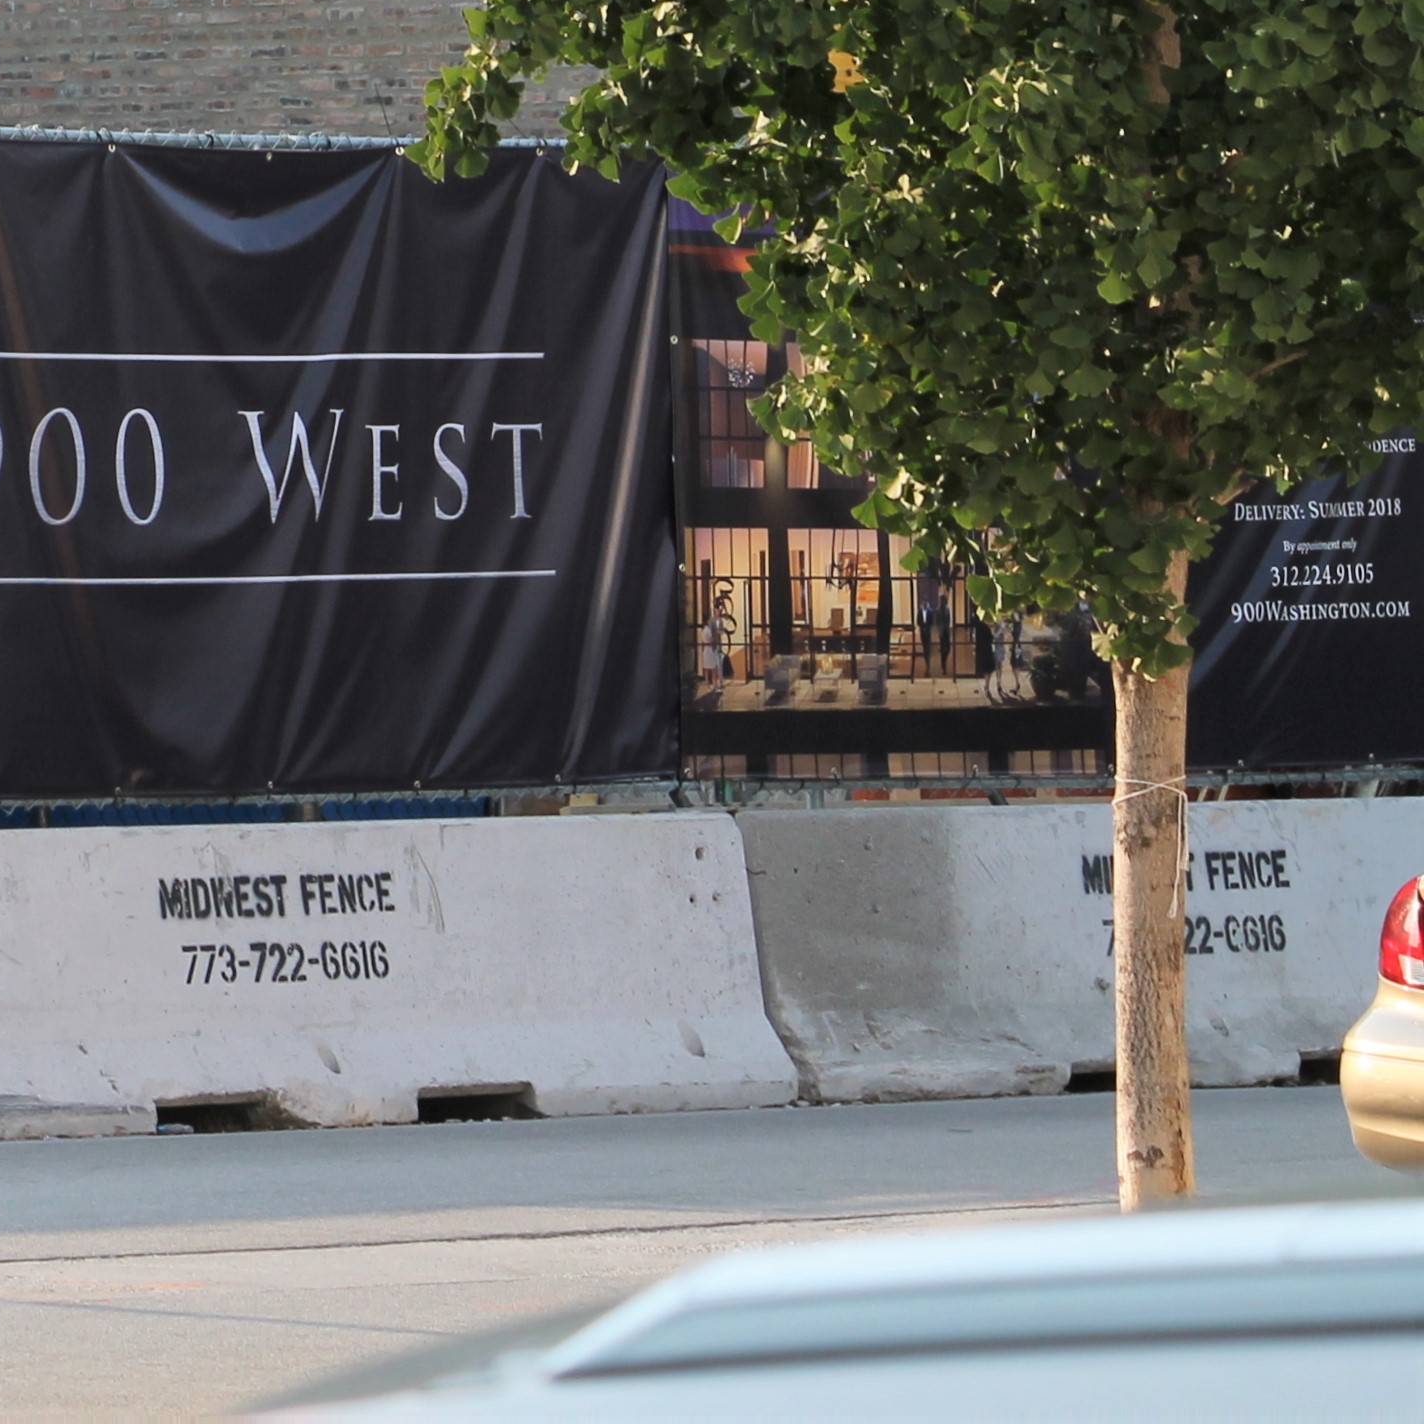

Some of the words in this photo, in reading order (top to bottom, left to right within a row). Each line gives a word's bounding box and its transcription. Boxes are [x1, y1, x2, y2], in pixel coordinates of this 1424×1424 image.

[237, 408, 543, 525] WEST
[1234, 502, 1306, 521] DELIVERY:
[1308, 499, 1365, 518] SUMMER
[1368, 498, 1401, 516] 2018
[1283, 540, 1296, 554] By
[1270, 563, 1374, 587] 312.224.9105
[1231, 600, 1410, 623] 900WASHINGTON.COM
[1205, 850, 1290, 890] FENCE
[159, 875, 287, 919] MIDWEST
[300, 872, 395, 915] FENCE
[182, 940, 390, 984] 773-722-6616
